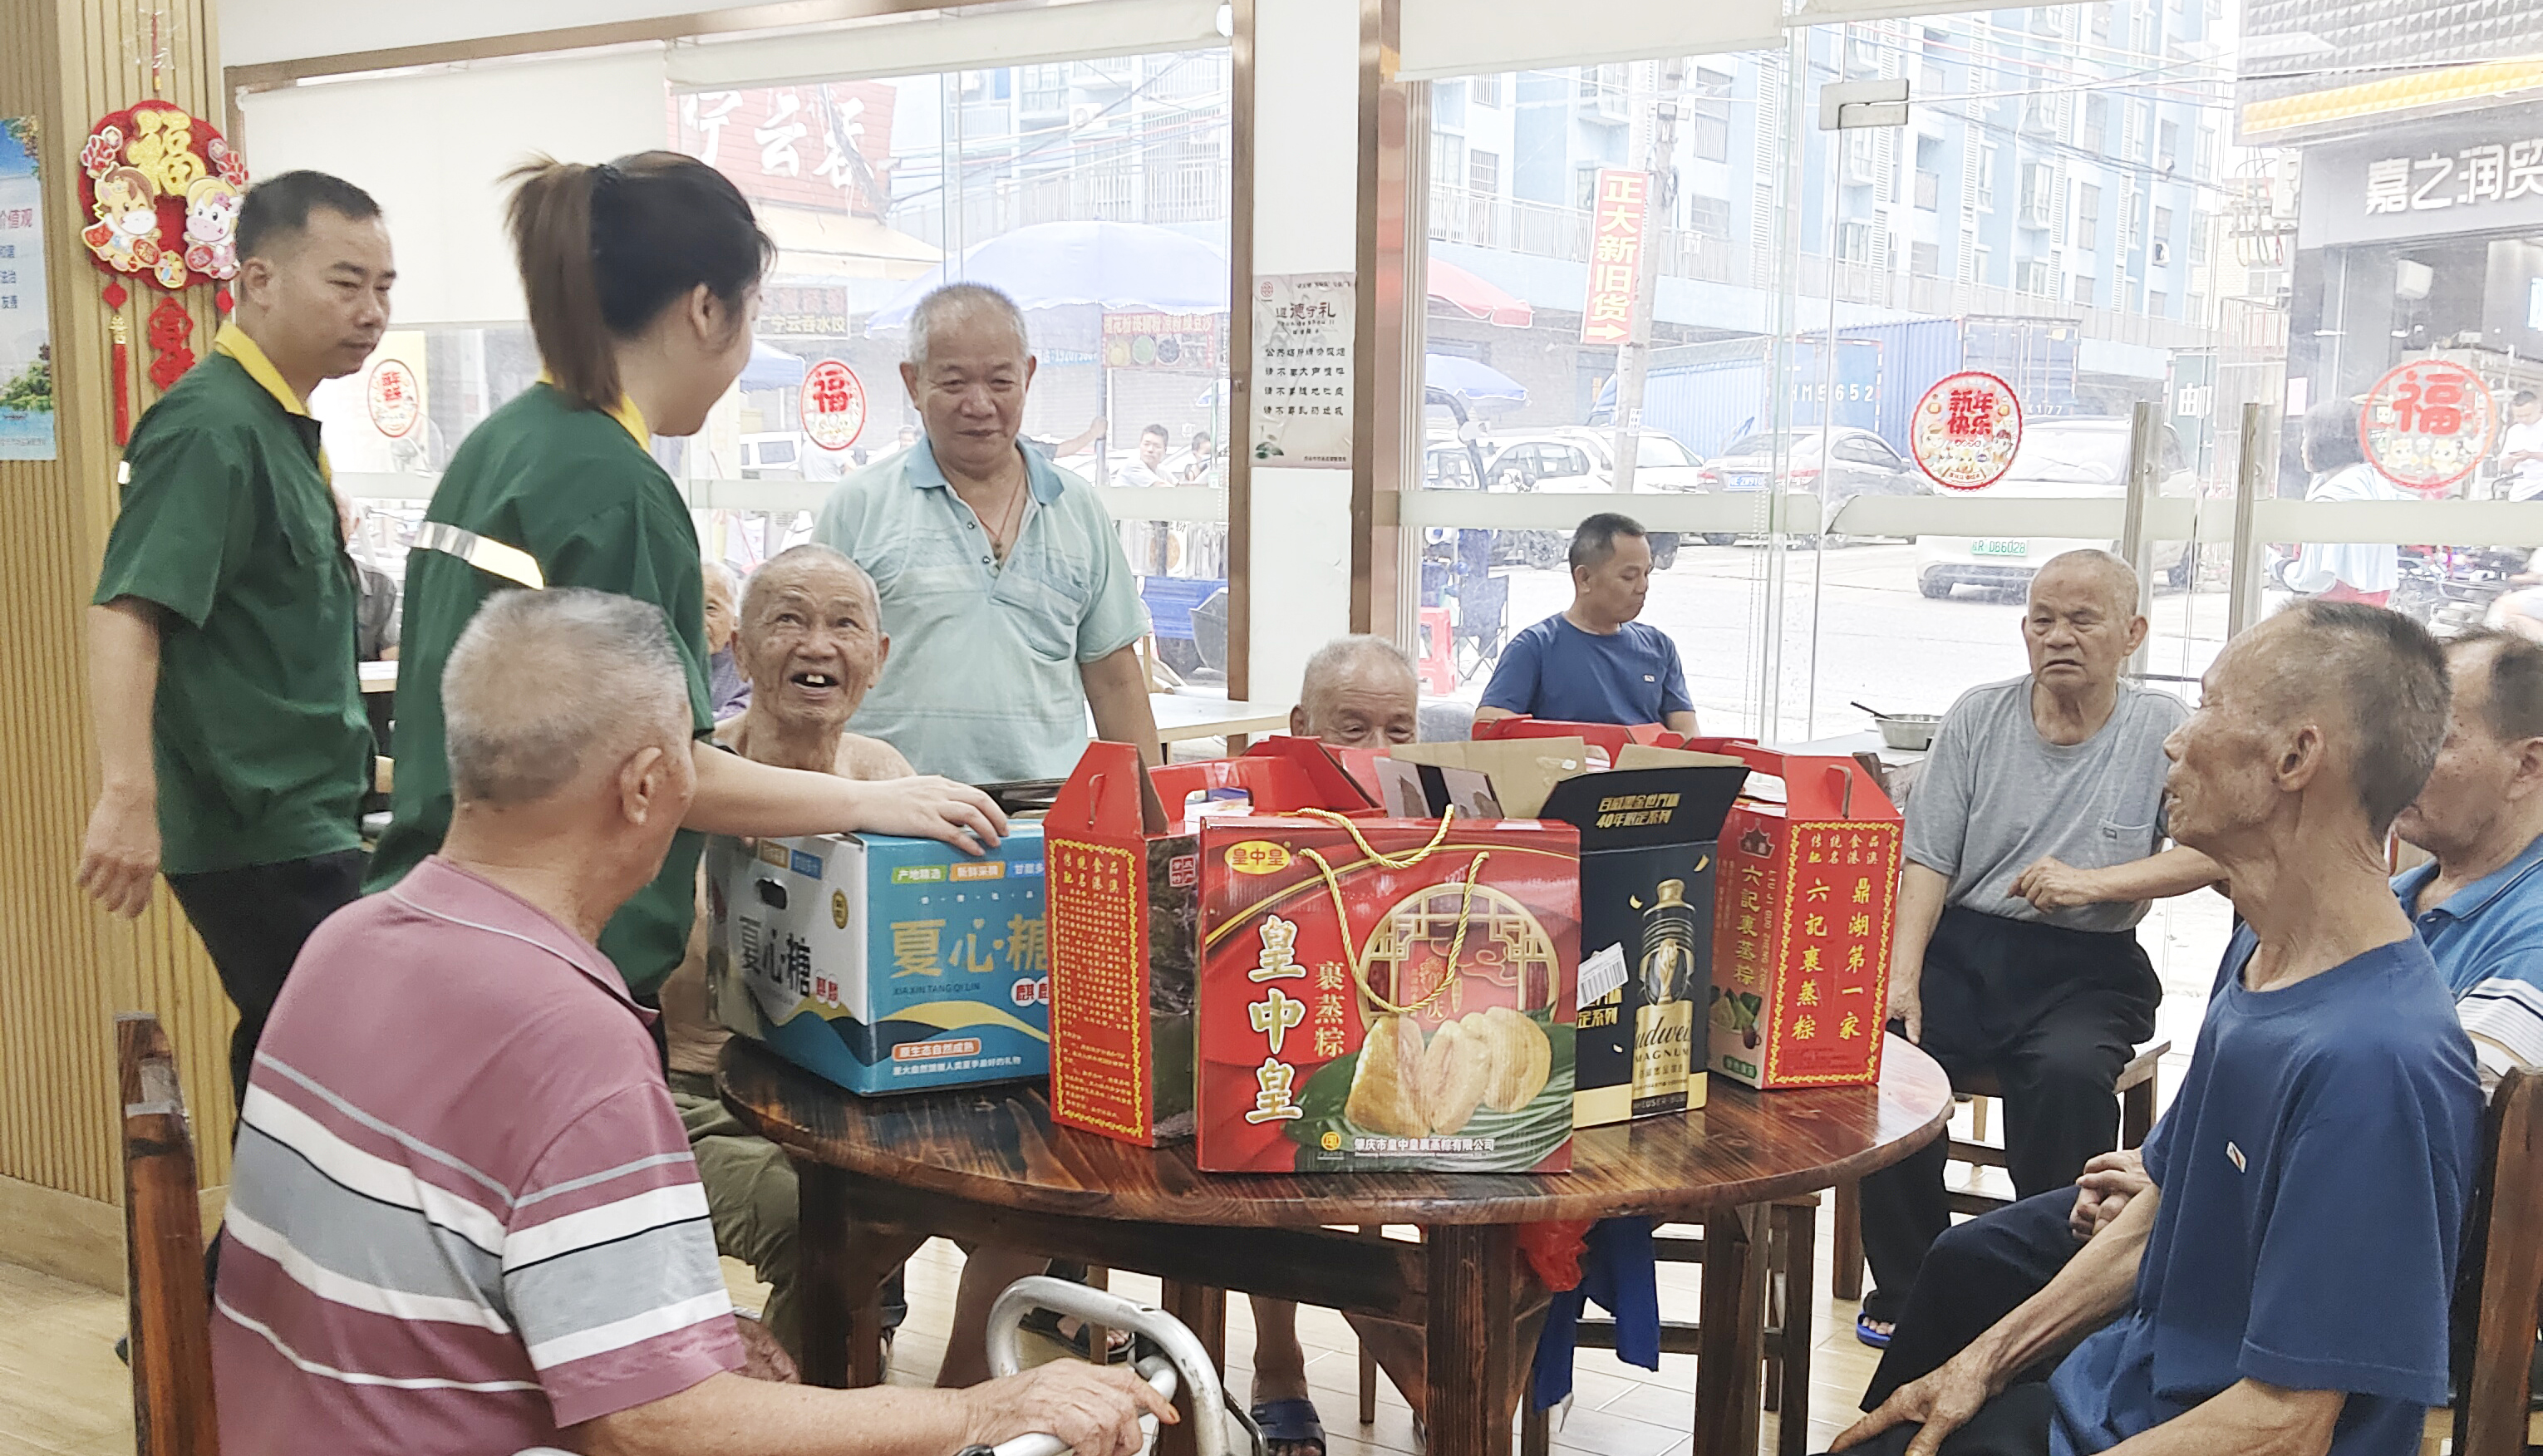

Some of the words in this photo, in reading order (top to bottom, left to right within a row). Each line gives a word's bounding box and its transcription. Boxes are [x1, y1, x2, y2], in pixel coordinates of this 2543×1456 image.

[127, 110, 207, 196] 福
[2366, 139, 2543, 215] 嘉之润贸
[1590, 175, 1643, 322] 正大新旧货
[813, 370, 848, 413] 福
[1947, 413, 1992, 435] 快乐
[1949, 389, 1994, 413] 新年
[2393, 371, 2465, 435] 福
[1232, 847, 1284, 866] 皇中皇
[1839, 878, 1871, 1040] 鼎湖第一家
[1246, 914, 1307, 1124] 皇中皇
[1314, 960, 1345, 1058] 裹蒸粽
[899, 1041, 975, 1057] 原生态自然成熟
